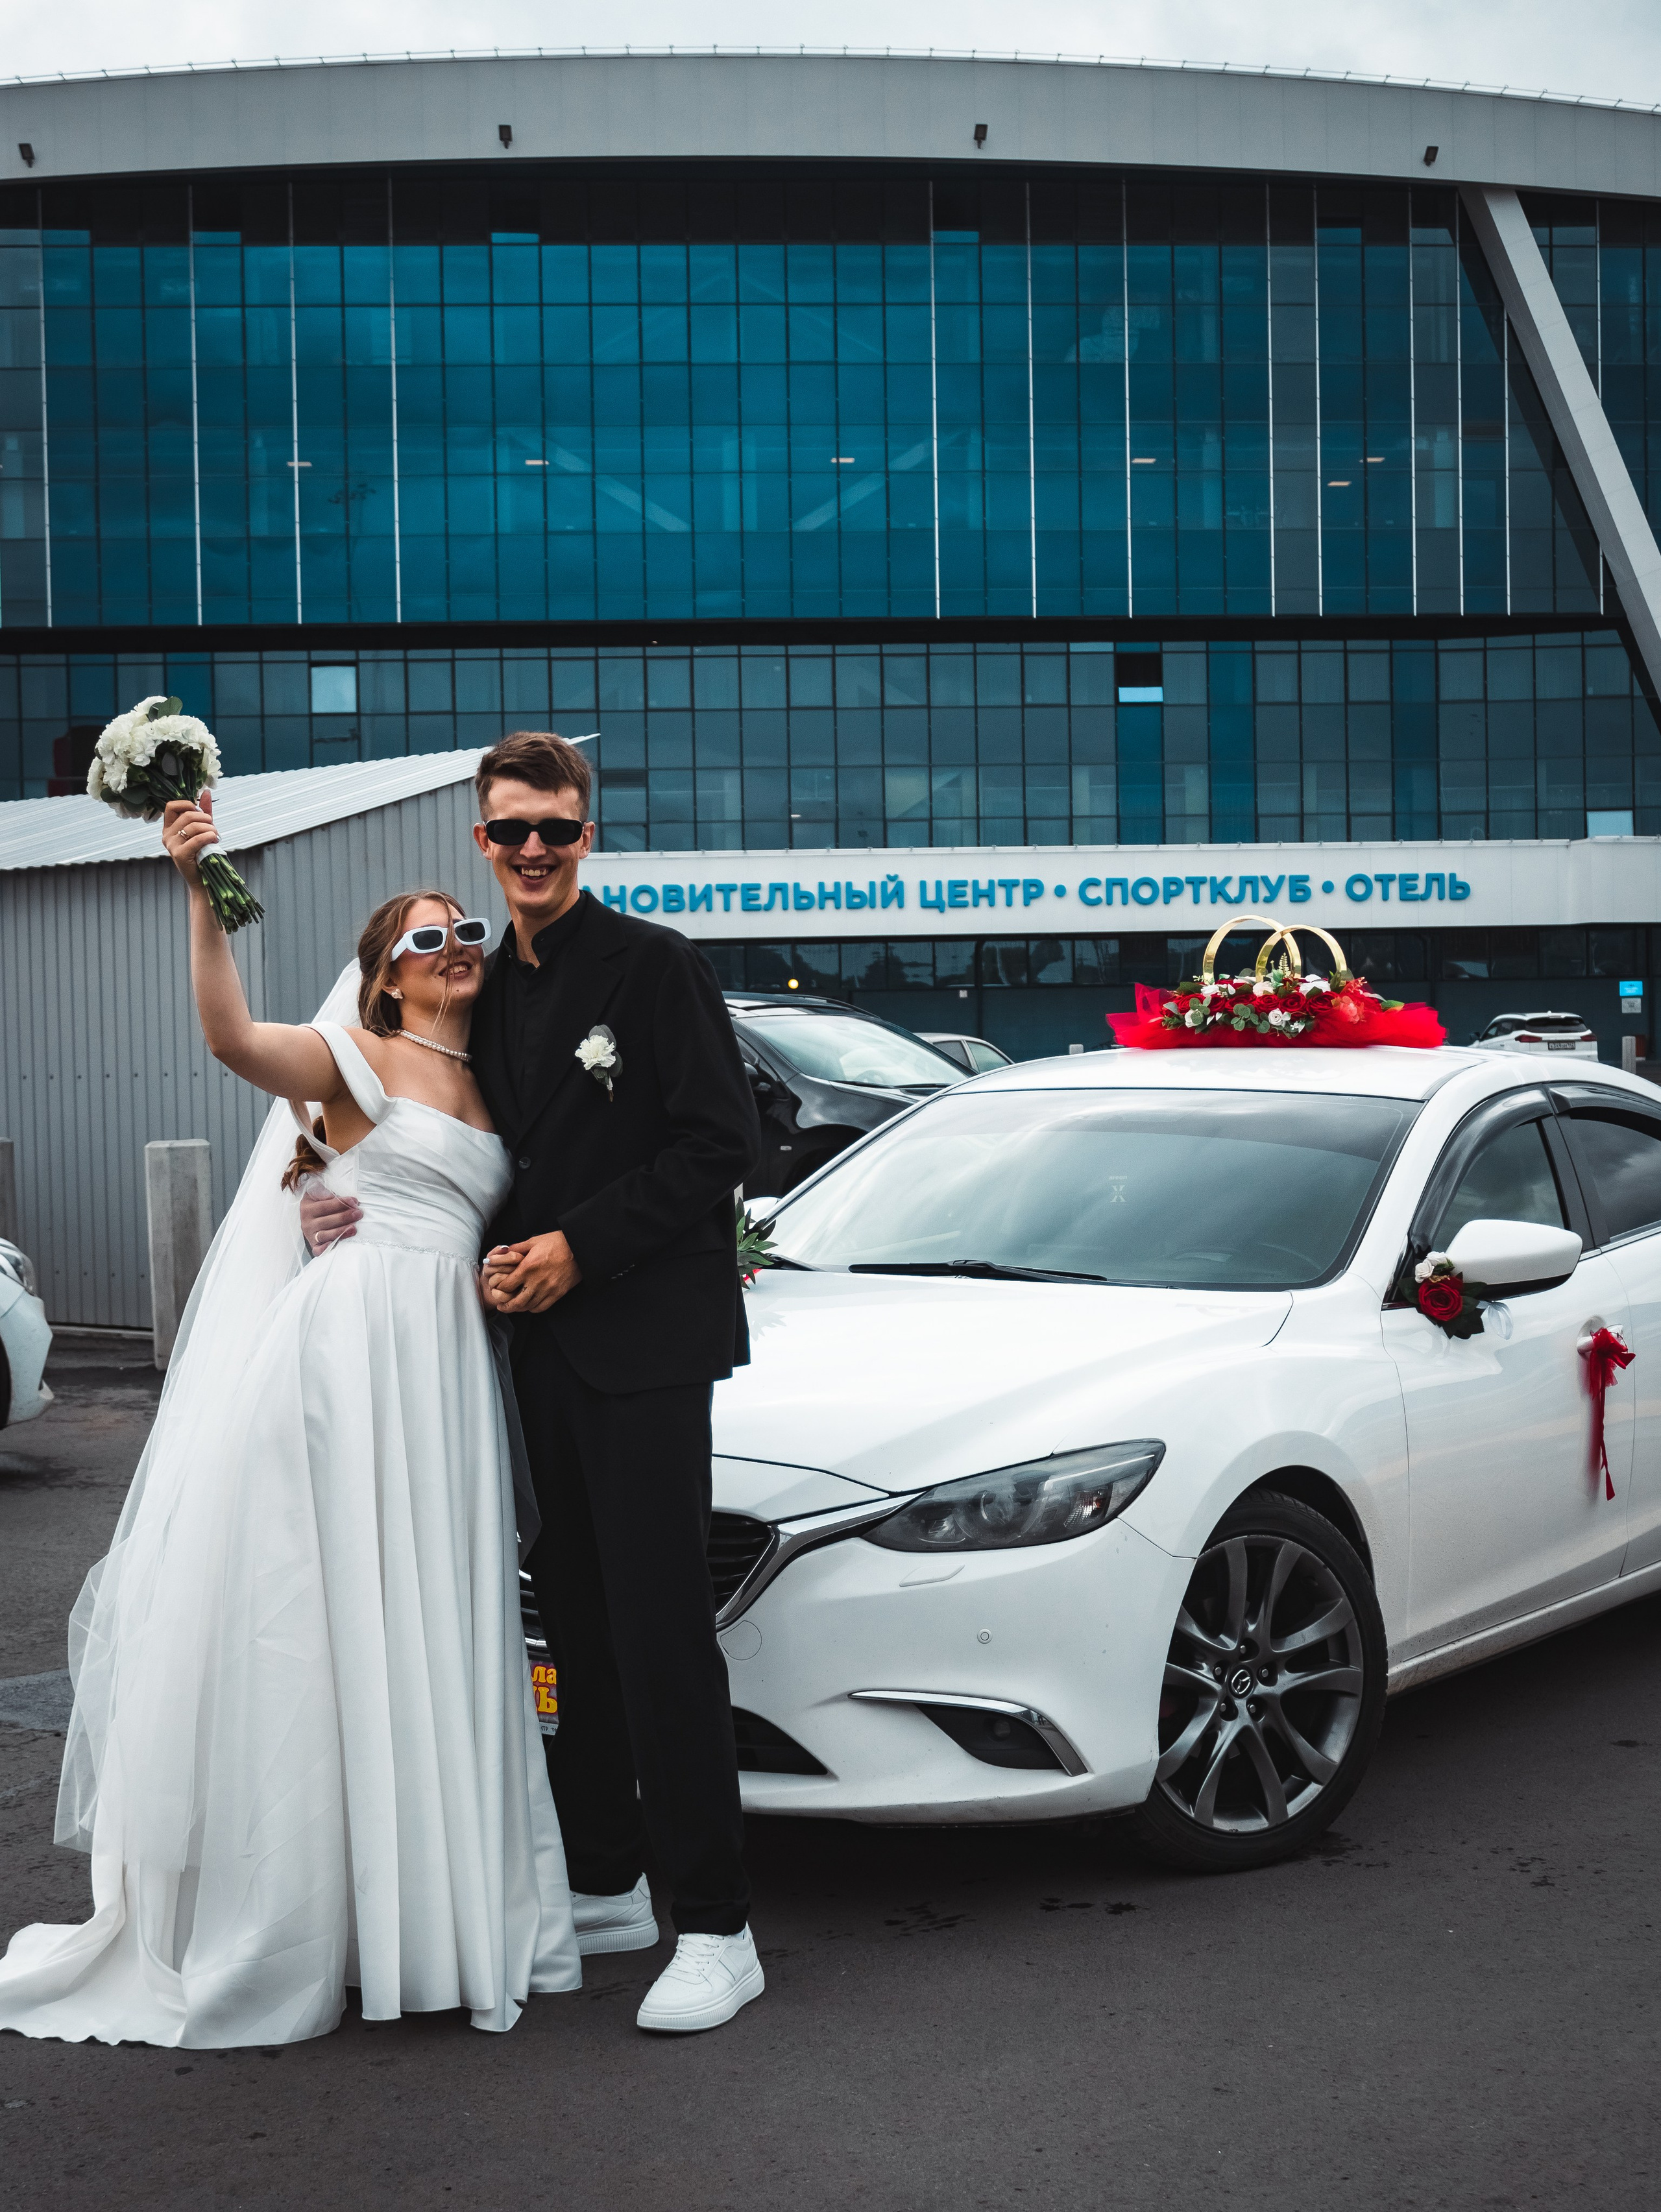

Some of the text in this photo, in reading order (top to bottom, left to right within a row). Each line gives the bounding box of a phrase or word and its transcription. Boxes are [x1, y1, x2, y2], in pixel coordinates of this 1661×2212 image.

[919, 879, 1045, 913] ЦЕНТР
[1078, 874, 1311, 906] СПОРТКЛУБ
[1345, 872, 1471, 902] ОТЕЛЬ
